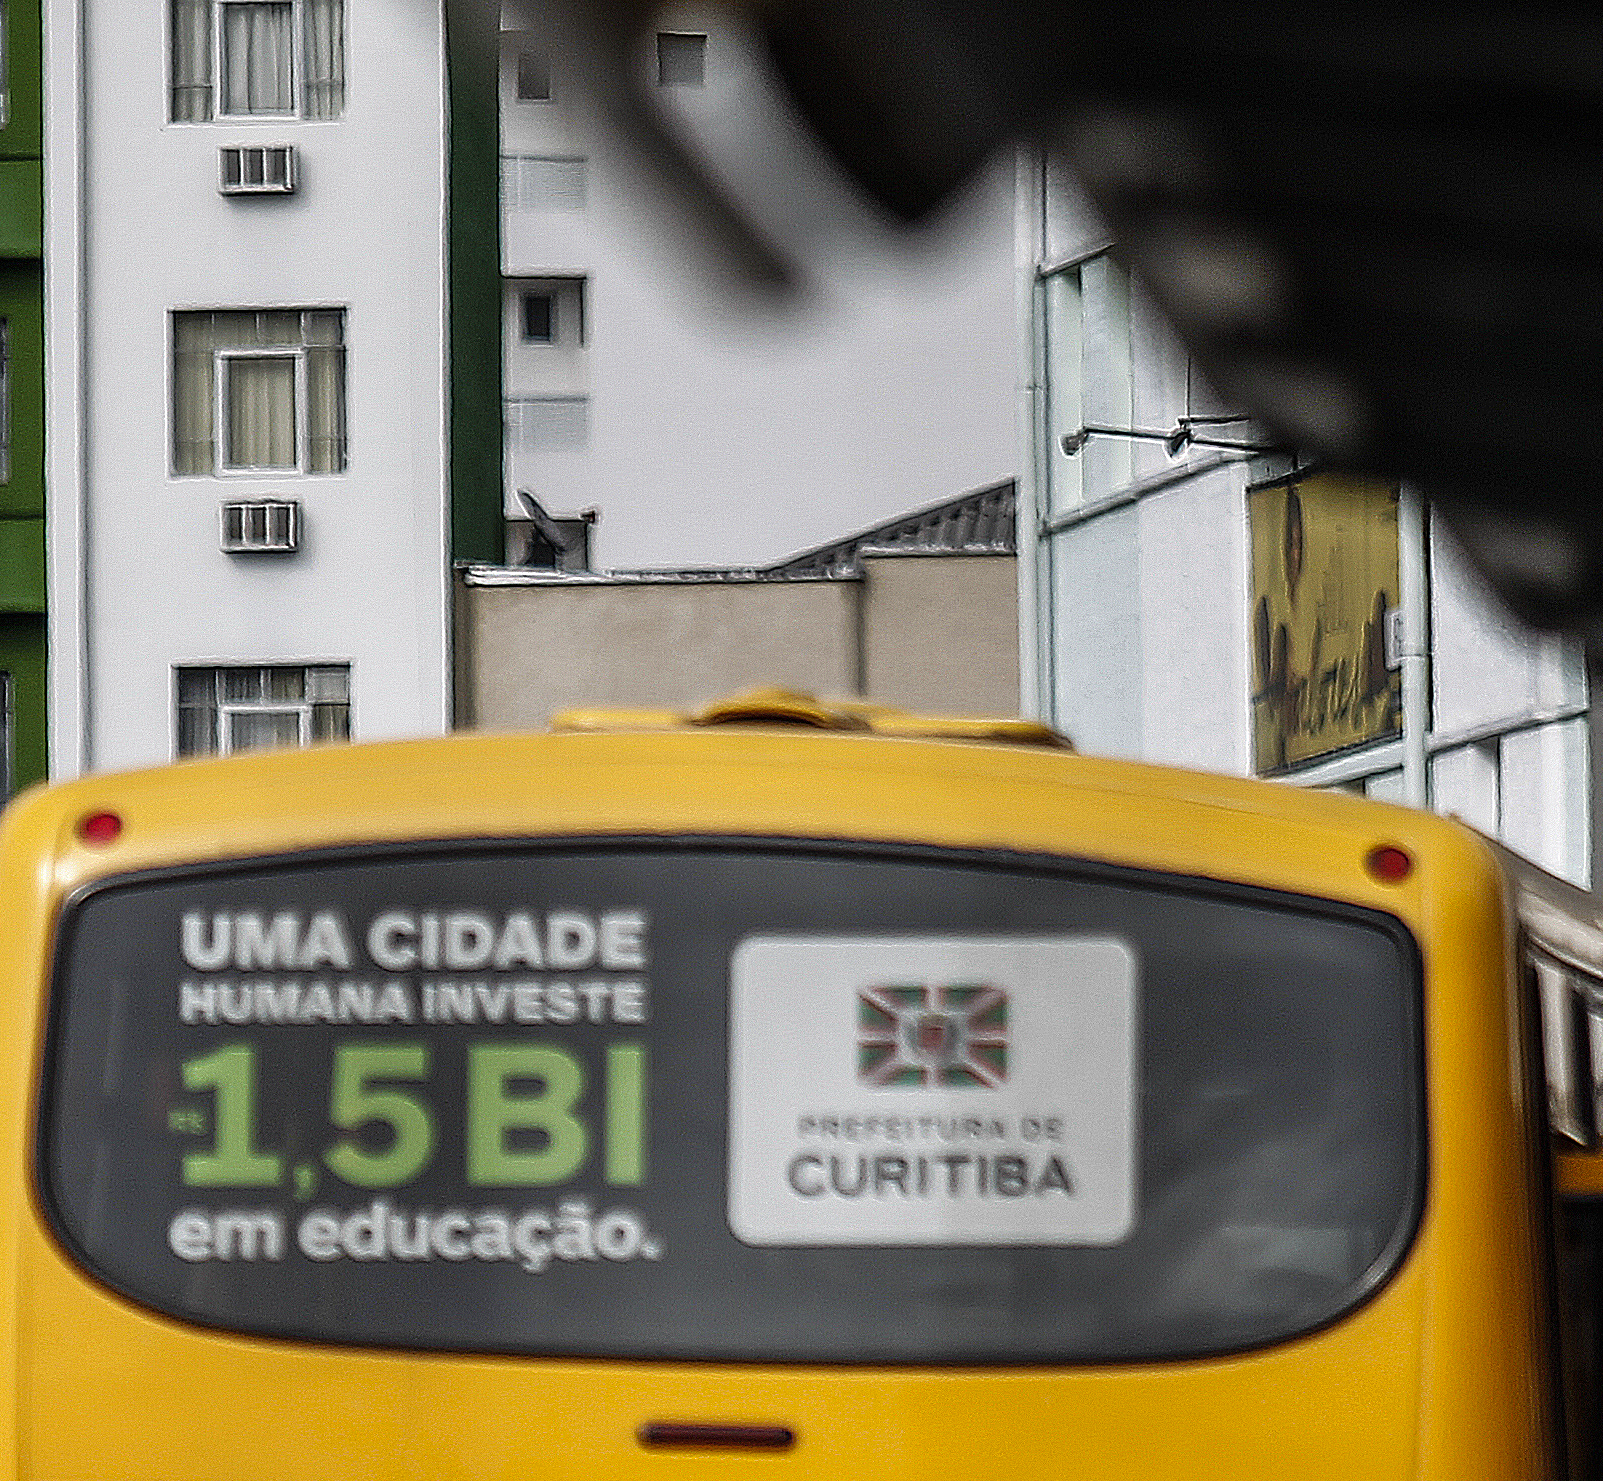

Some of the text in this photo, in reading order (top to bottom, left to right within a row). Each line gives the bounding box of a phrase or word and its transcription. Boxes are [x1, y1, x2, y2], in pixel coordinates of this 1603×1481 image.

[181, 910, 648, 972] UMA CIDADE
[180, 981, 647, 1026] HUMANA INVESTE
[466, 1043, 646, 1187] BI
[800, 1115, 1063, 1142] PREFEITURA DE
[789, 1154, 1076, 1198] CURITIBA
[169, 1201, 664, 1274] em educação.
